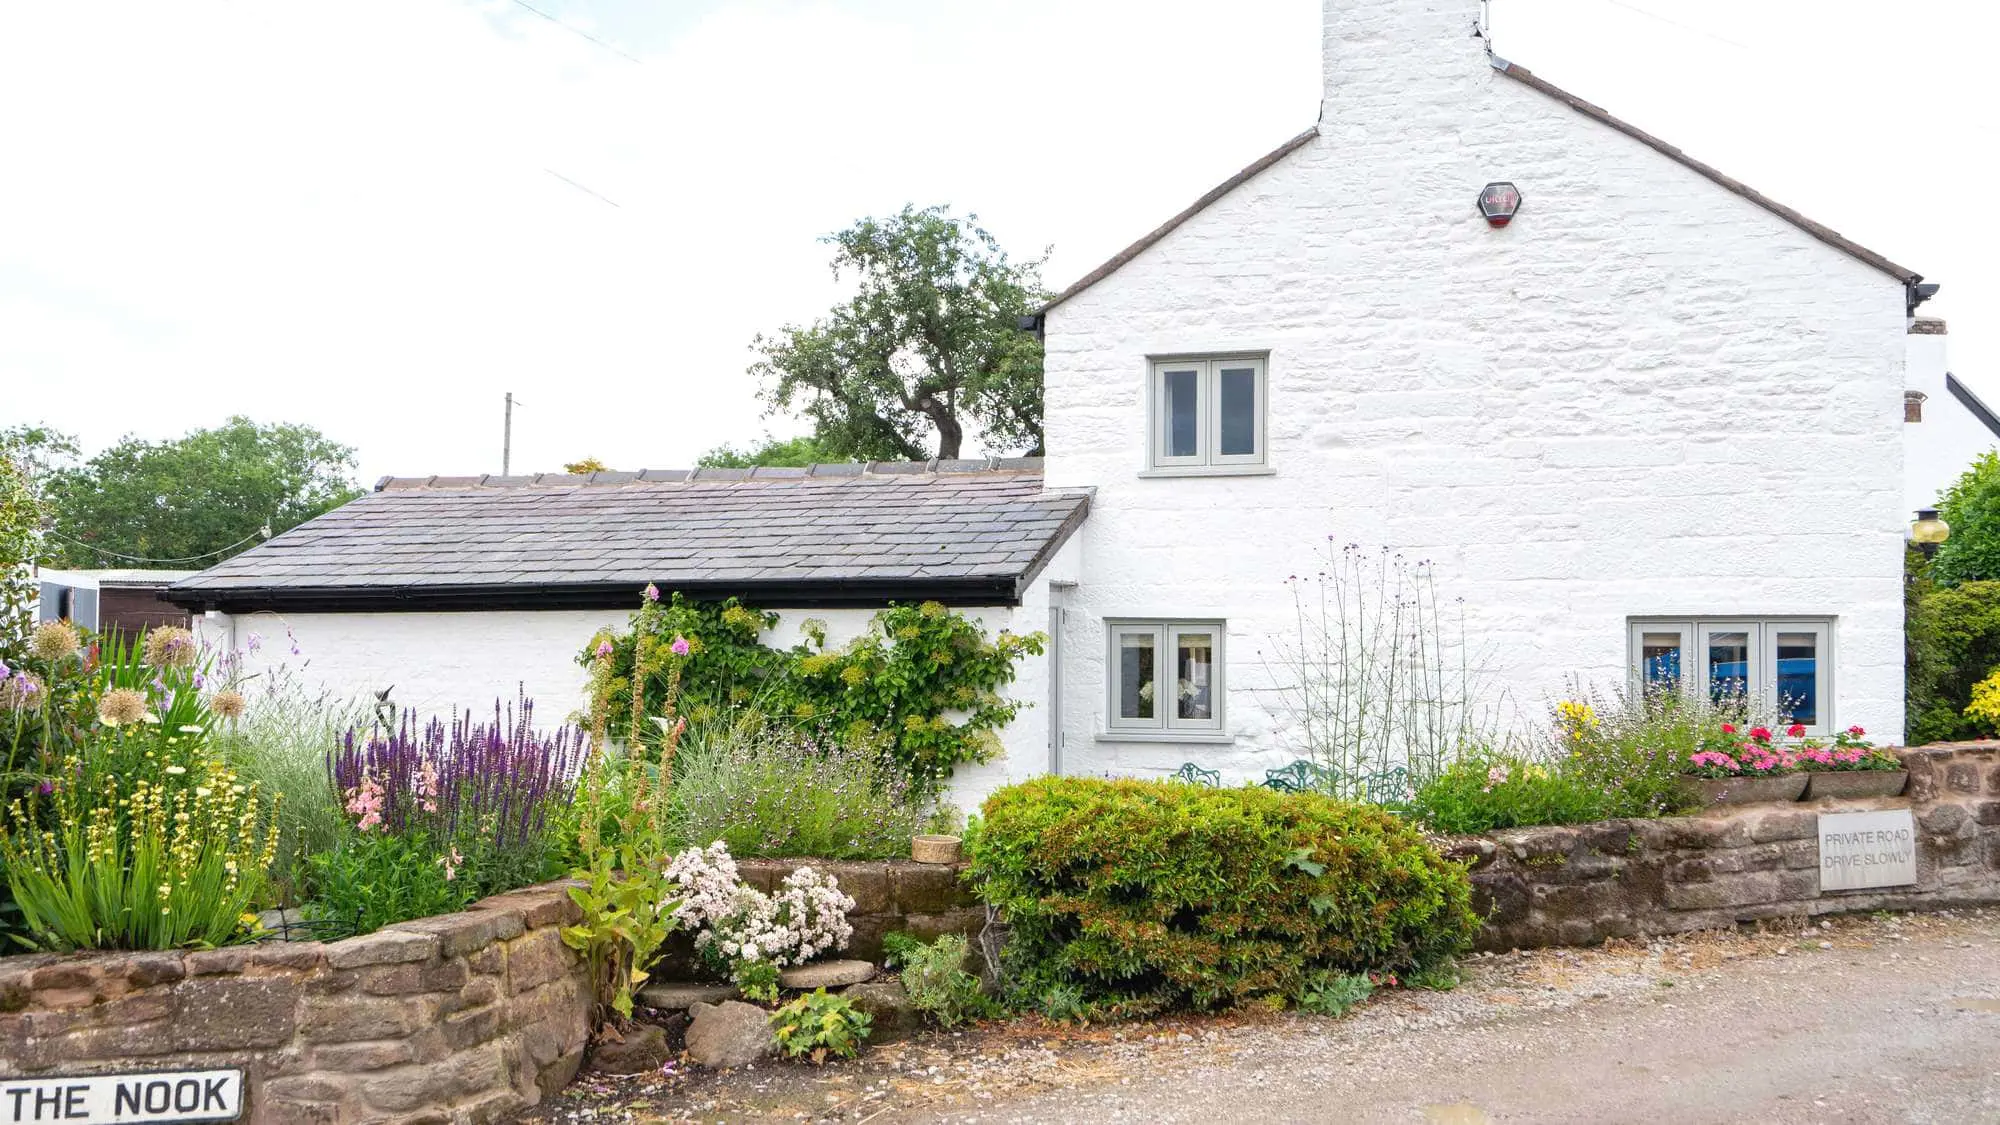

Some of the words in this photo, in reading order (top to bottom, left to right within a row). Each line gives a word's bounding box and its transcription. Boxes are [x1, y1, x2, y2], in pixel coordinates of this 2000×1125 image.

[1825, 832, 1874, 845] PRIVATE
[1876, 829, 1909, 842] ROAD
[1824, 854, 1860, 868] DRIVE
[1864, 850, 1912, 865] SLOWLY
[6, 1085, 90, 1121] THE
[115, 1077, 230, 1116] NOOK
